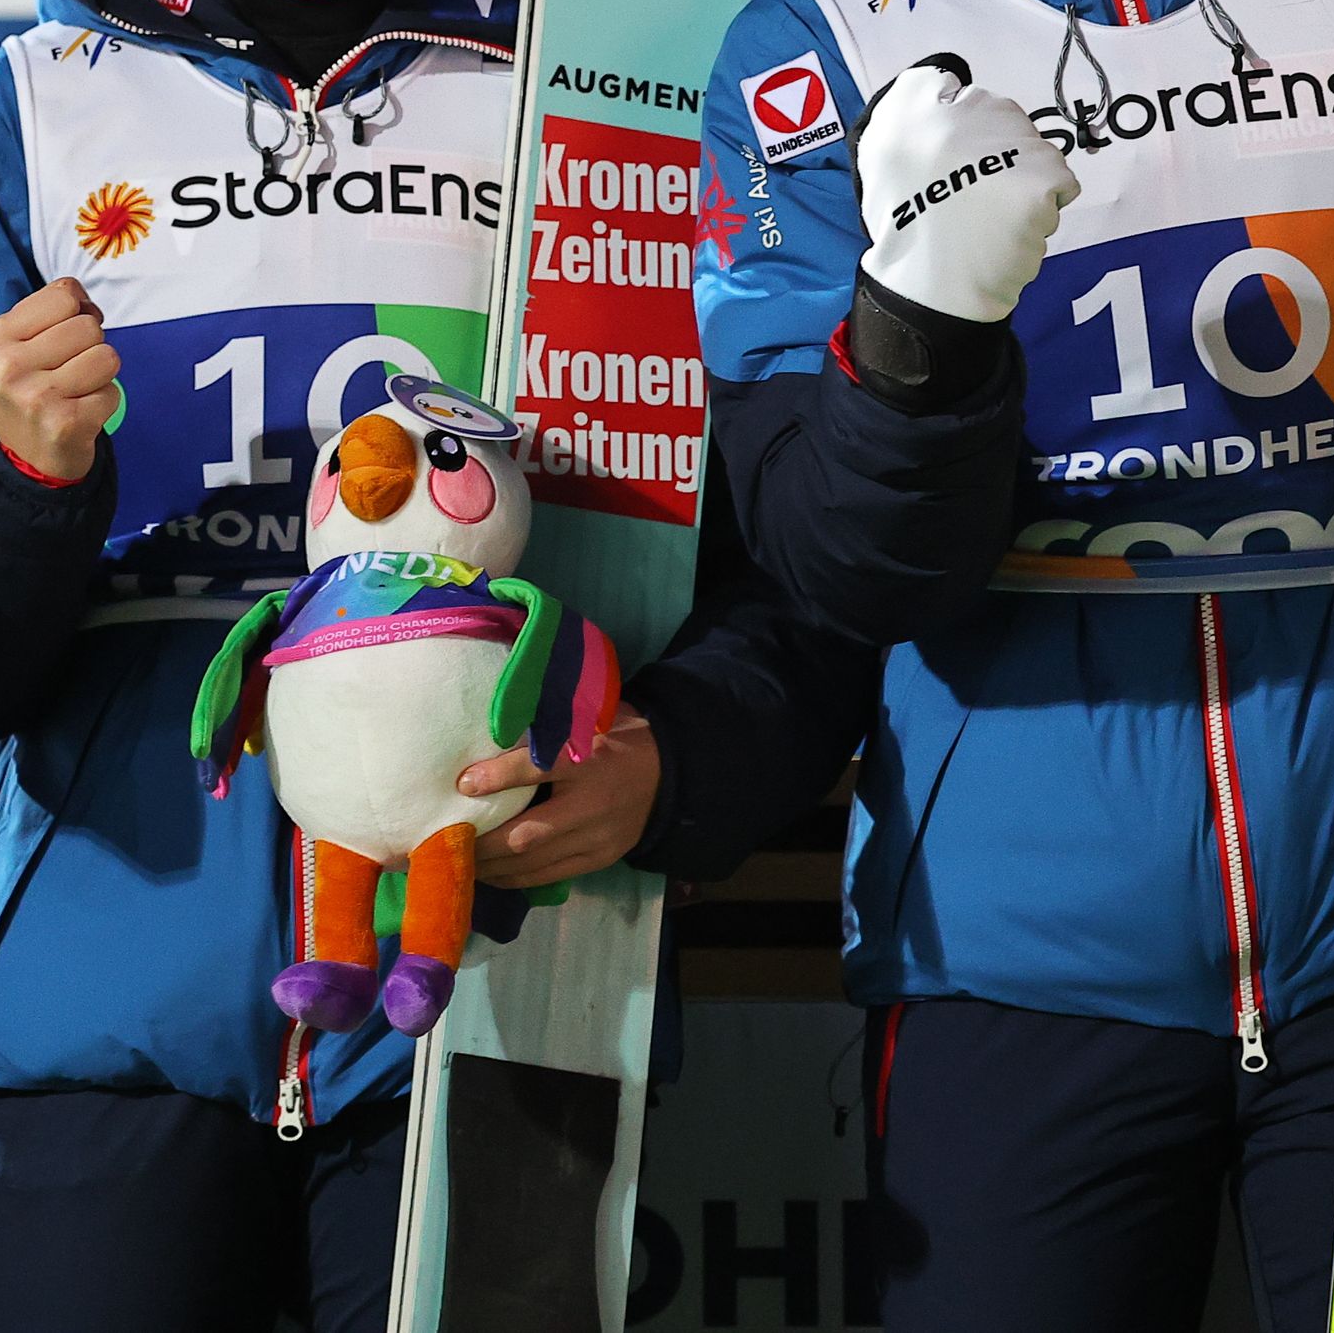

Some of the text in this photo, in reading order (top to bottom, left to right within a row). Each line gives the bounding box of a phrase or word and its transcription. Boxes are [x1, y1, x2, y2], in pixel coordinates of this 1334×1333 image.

[548, 64, 707, 114] AUGMEN
[766, 121, 840, 158] BUNDESHEER
[891, 148, 1020, 232] ziener
[531, 219, 695, 291] Zeitun
[753, 206, 783, 250] Ski
[515, 332, 705, 408] Kronen
[1070, 246, 1331, 422] 10
[513, 410, 703, 494] Zeitung
[308, 627, 391, 657] TRONDHEIM
